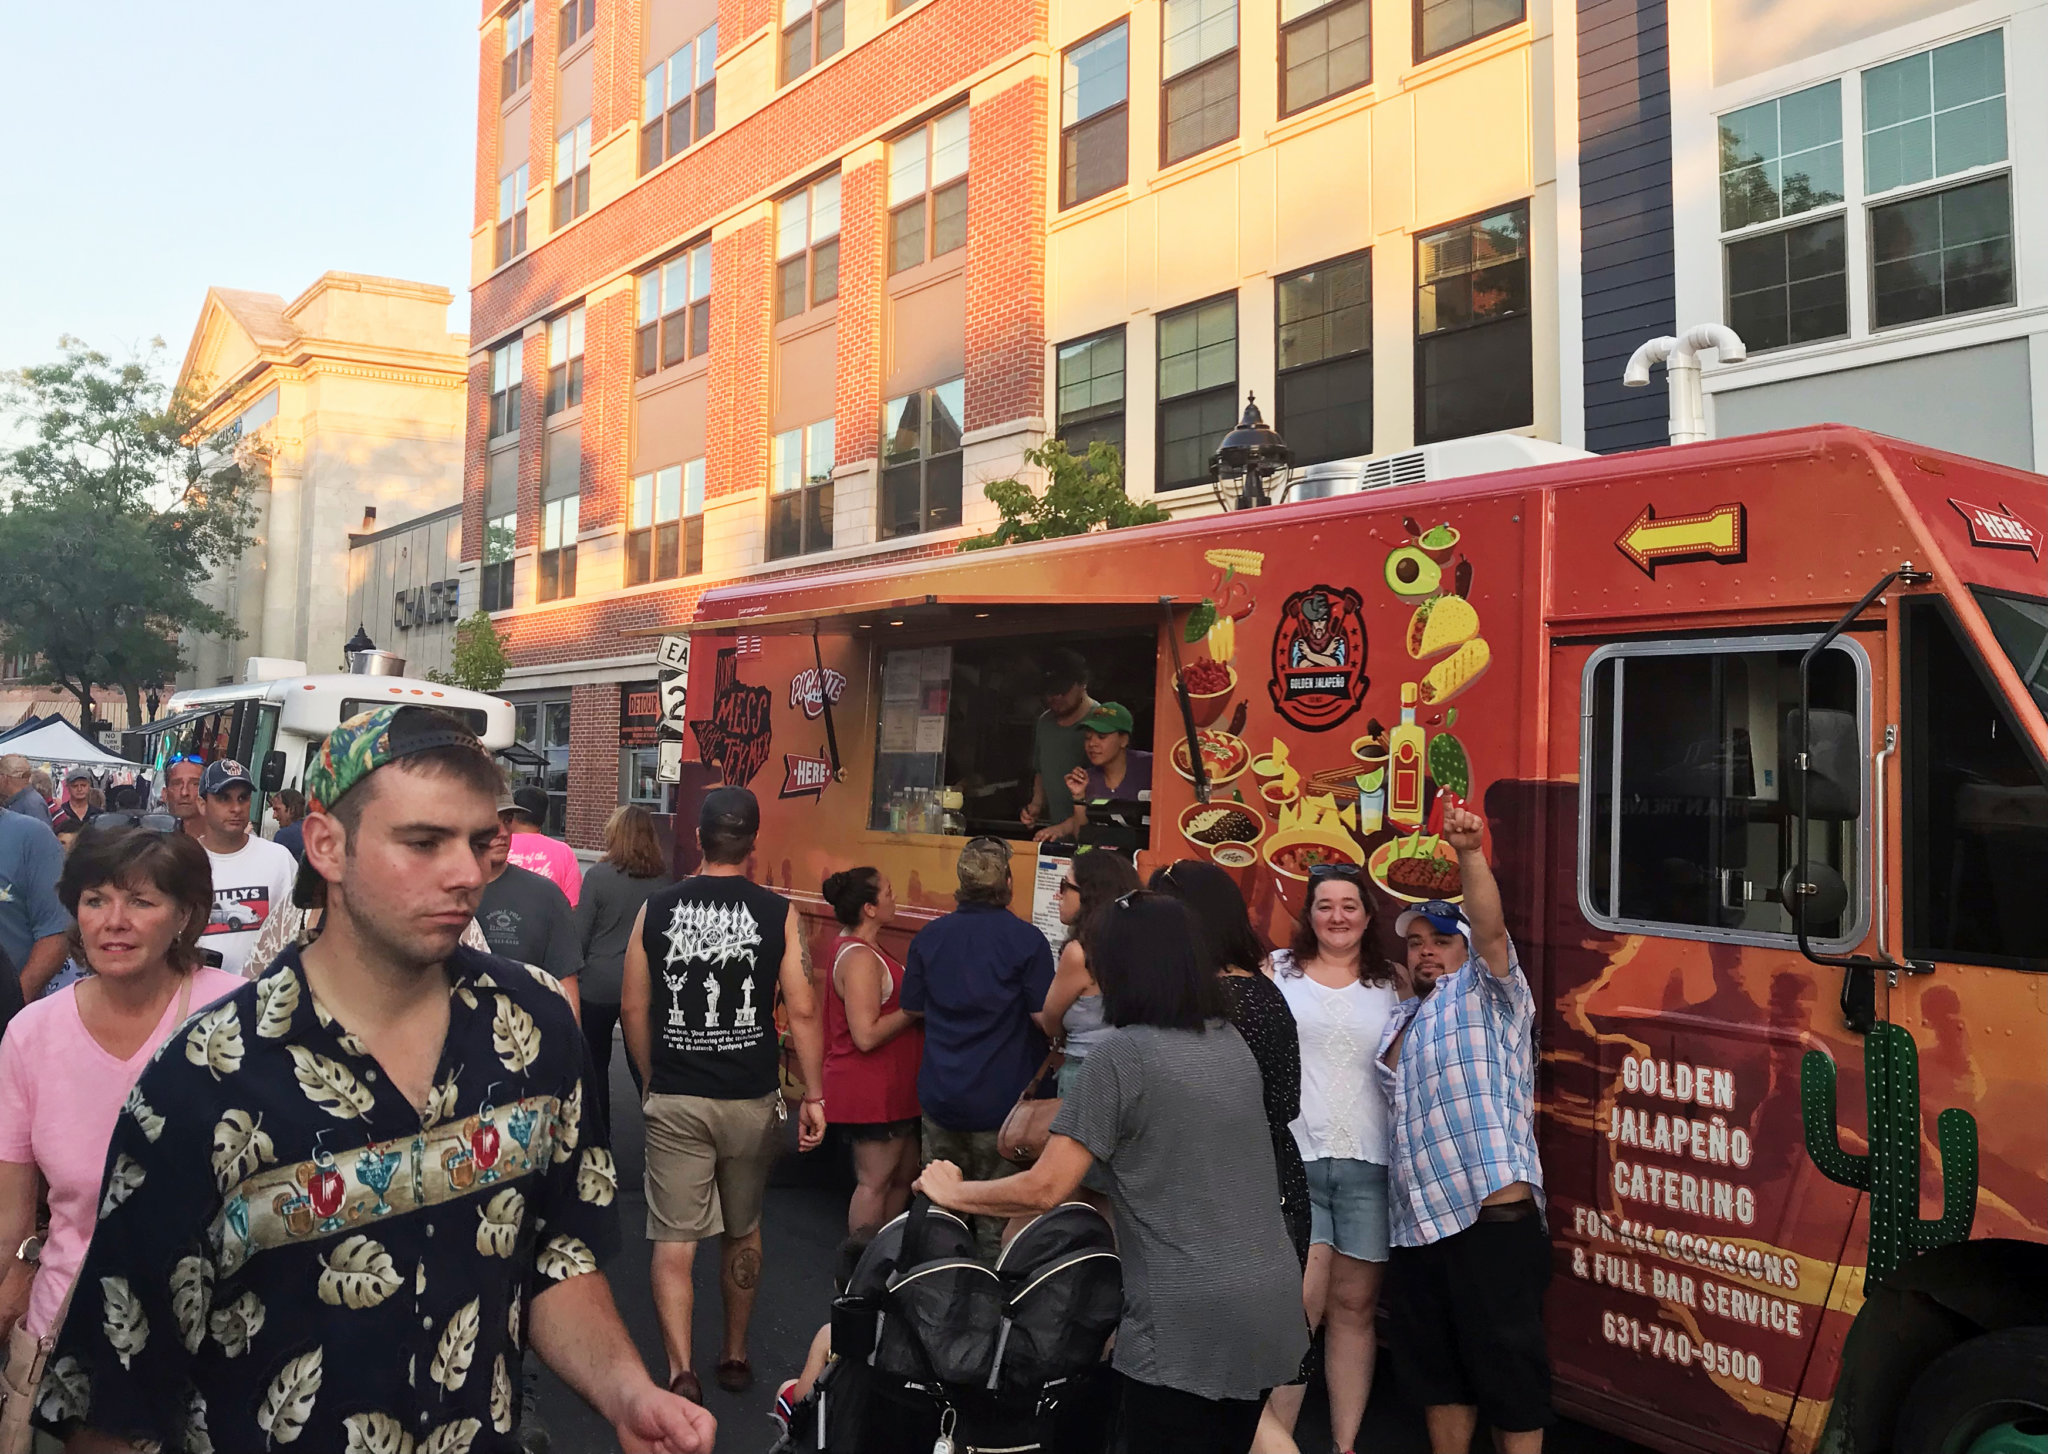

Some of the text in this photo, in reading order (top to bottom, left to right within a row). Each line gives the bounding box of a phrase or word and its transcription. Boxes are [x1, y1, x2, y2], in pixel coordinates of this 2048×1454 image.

[1974, 509, 2032, 542] HERE
[394, 579, 460, 629] CHASE
[666, 642, 688, 665] EA
[790, 669, 848, 708] PICANTE
[1290, 674, 1345, 690] GOLDEN JALAPEÑO
[630, 695, 657, 714] DETOUR
[667, 685, 687, 721] 2
[715, 691, 768, 735] MESS
[796, 758, 827, 786] HERE
[534, 851, 548, 861] the
[215, 888, 261, 901] ILLYS
[668, 898, 759, 936] MORBID
[684, 1036, 692, 1044] the
[694, 1037, 718, 1045] gathering
[1622, 1056, 1735, 1110] GOLDEN
[1607, 1107, 1752, 1167] JALAPEÑO
[1614, 1161, 1755, 1225] CATERING
[1574, 1207, 1799, 1289] FOR ALL OCCASIONS
[1573, 1247, 1802, 1336] & FULL BAR SERVICE
[1602, 1311, 1762, 1386] 631-740-9500
